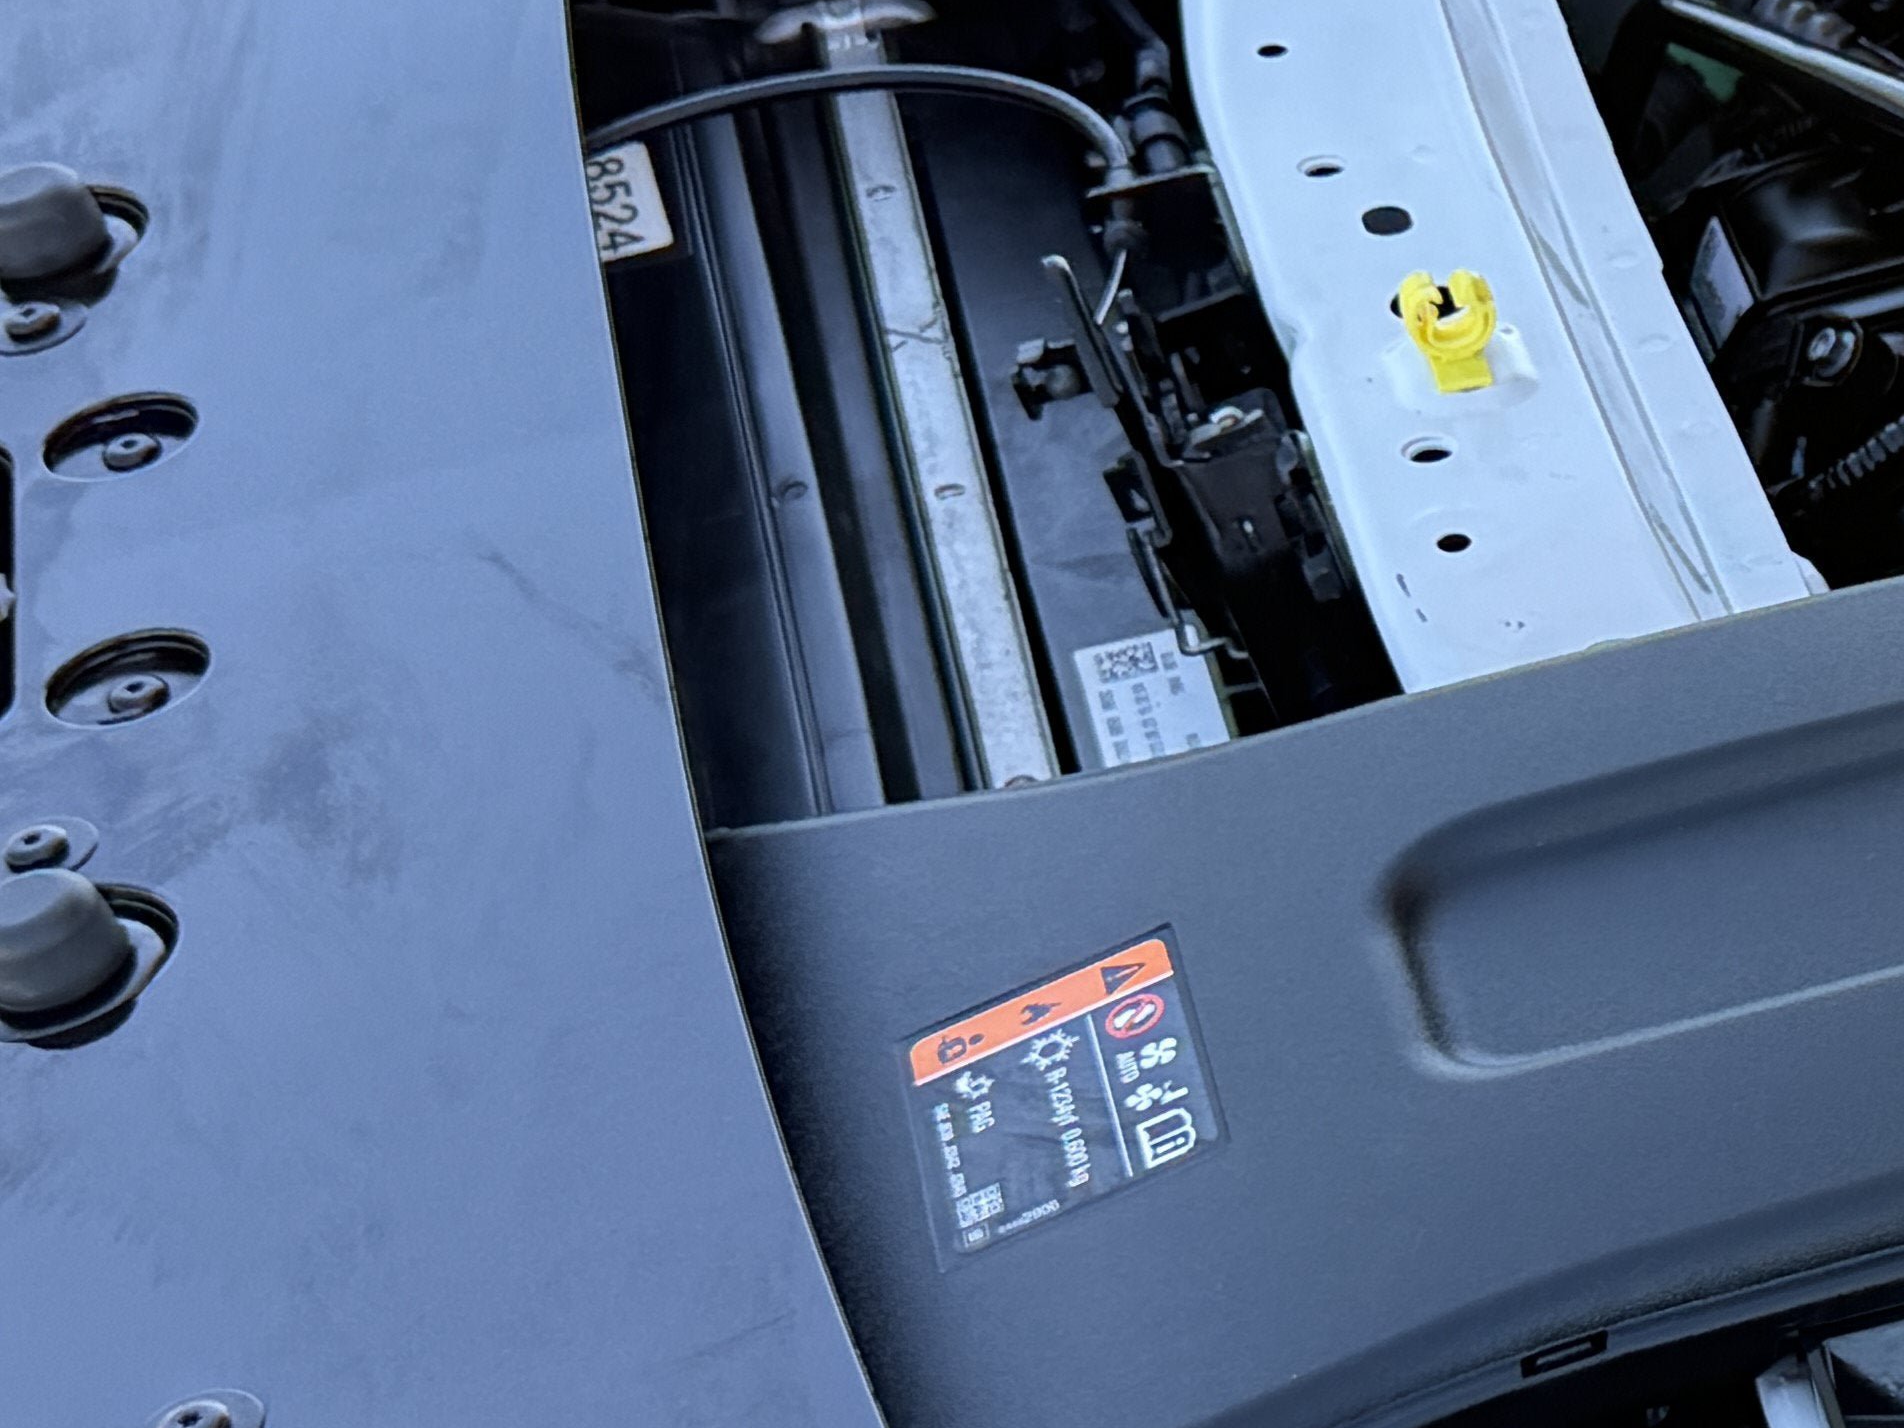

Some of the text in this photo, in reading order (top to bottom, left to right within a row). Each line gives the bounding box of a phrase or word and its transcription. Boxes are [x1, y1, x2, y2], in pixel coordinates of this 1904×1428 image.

[586, 158, 645, 254] 8524
[1115, 1051, 1140, 1083] AUTO
[967, 1101, 995, 1134] PAG
[1061, 1127, 1089, 1167] 0.600
[1065, 1163, 1091, 1188] kg
